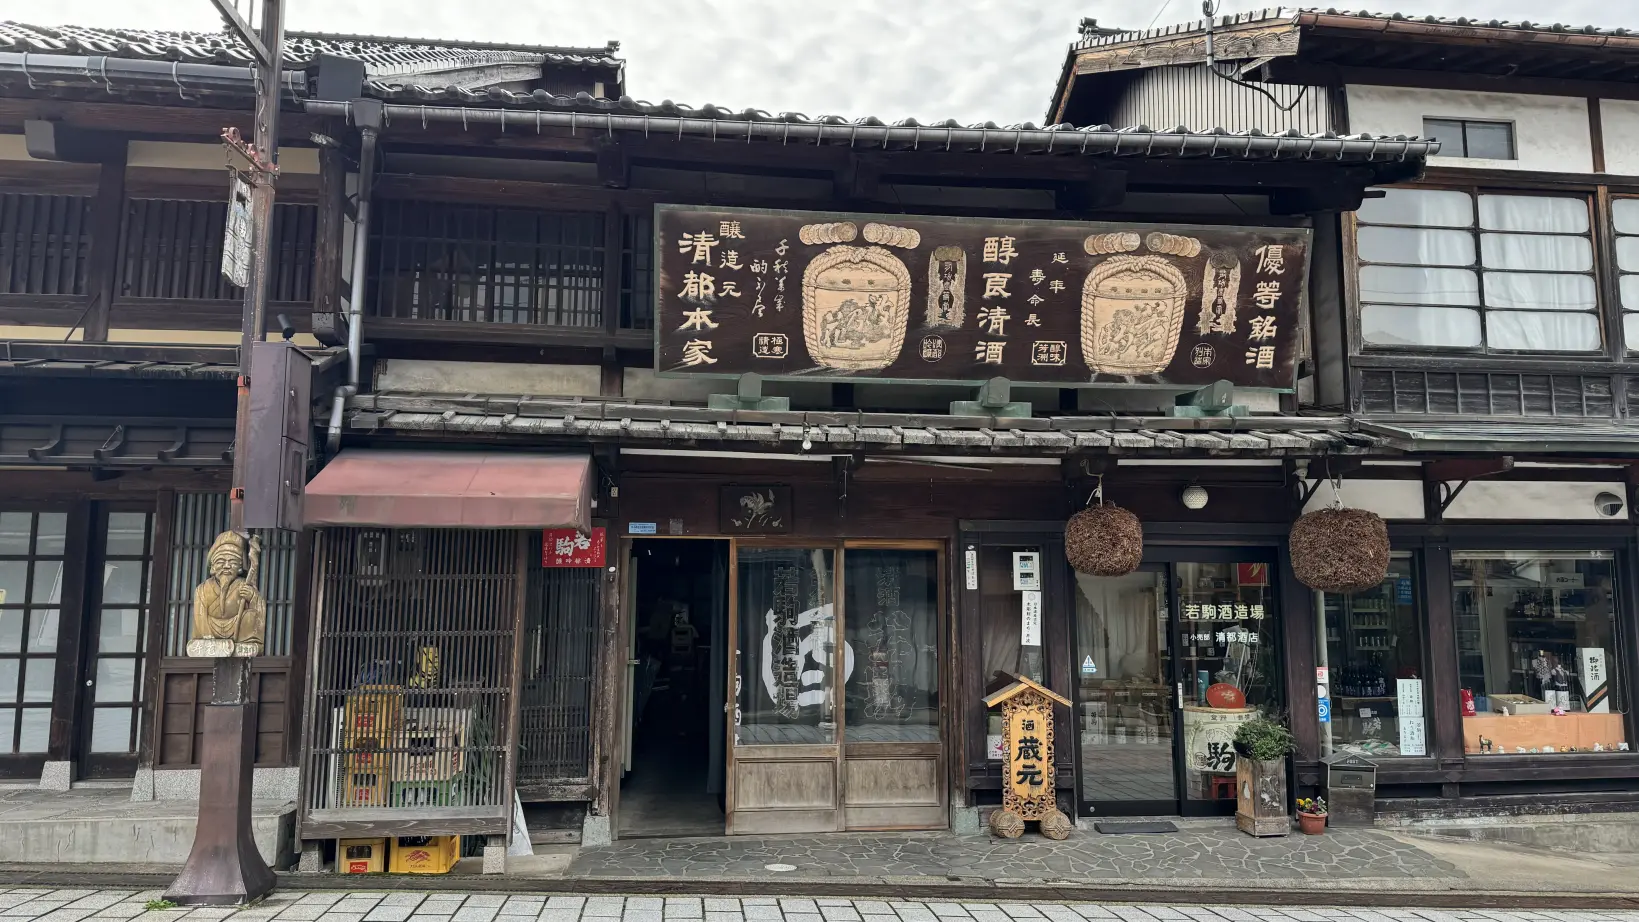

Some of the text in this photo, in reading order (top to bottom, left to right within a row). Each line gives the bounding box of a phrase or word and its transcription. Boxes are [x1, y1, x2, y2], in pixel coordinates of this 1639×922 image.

[677, 230, 719, 366] 清都本家
[975, 236, 1019, 364] 醇良清酒
[1245, 244, 1285, 369] 優等銘酒
[555, 530, 592, 557] 若駒
[773, 565, 801, 720] 若駒酒造場
[1184, 604, 1265, 621] 若駒酒造場
[1013, 719, 1044, 786] 酒蔵元
